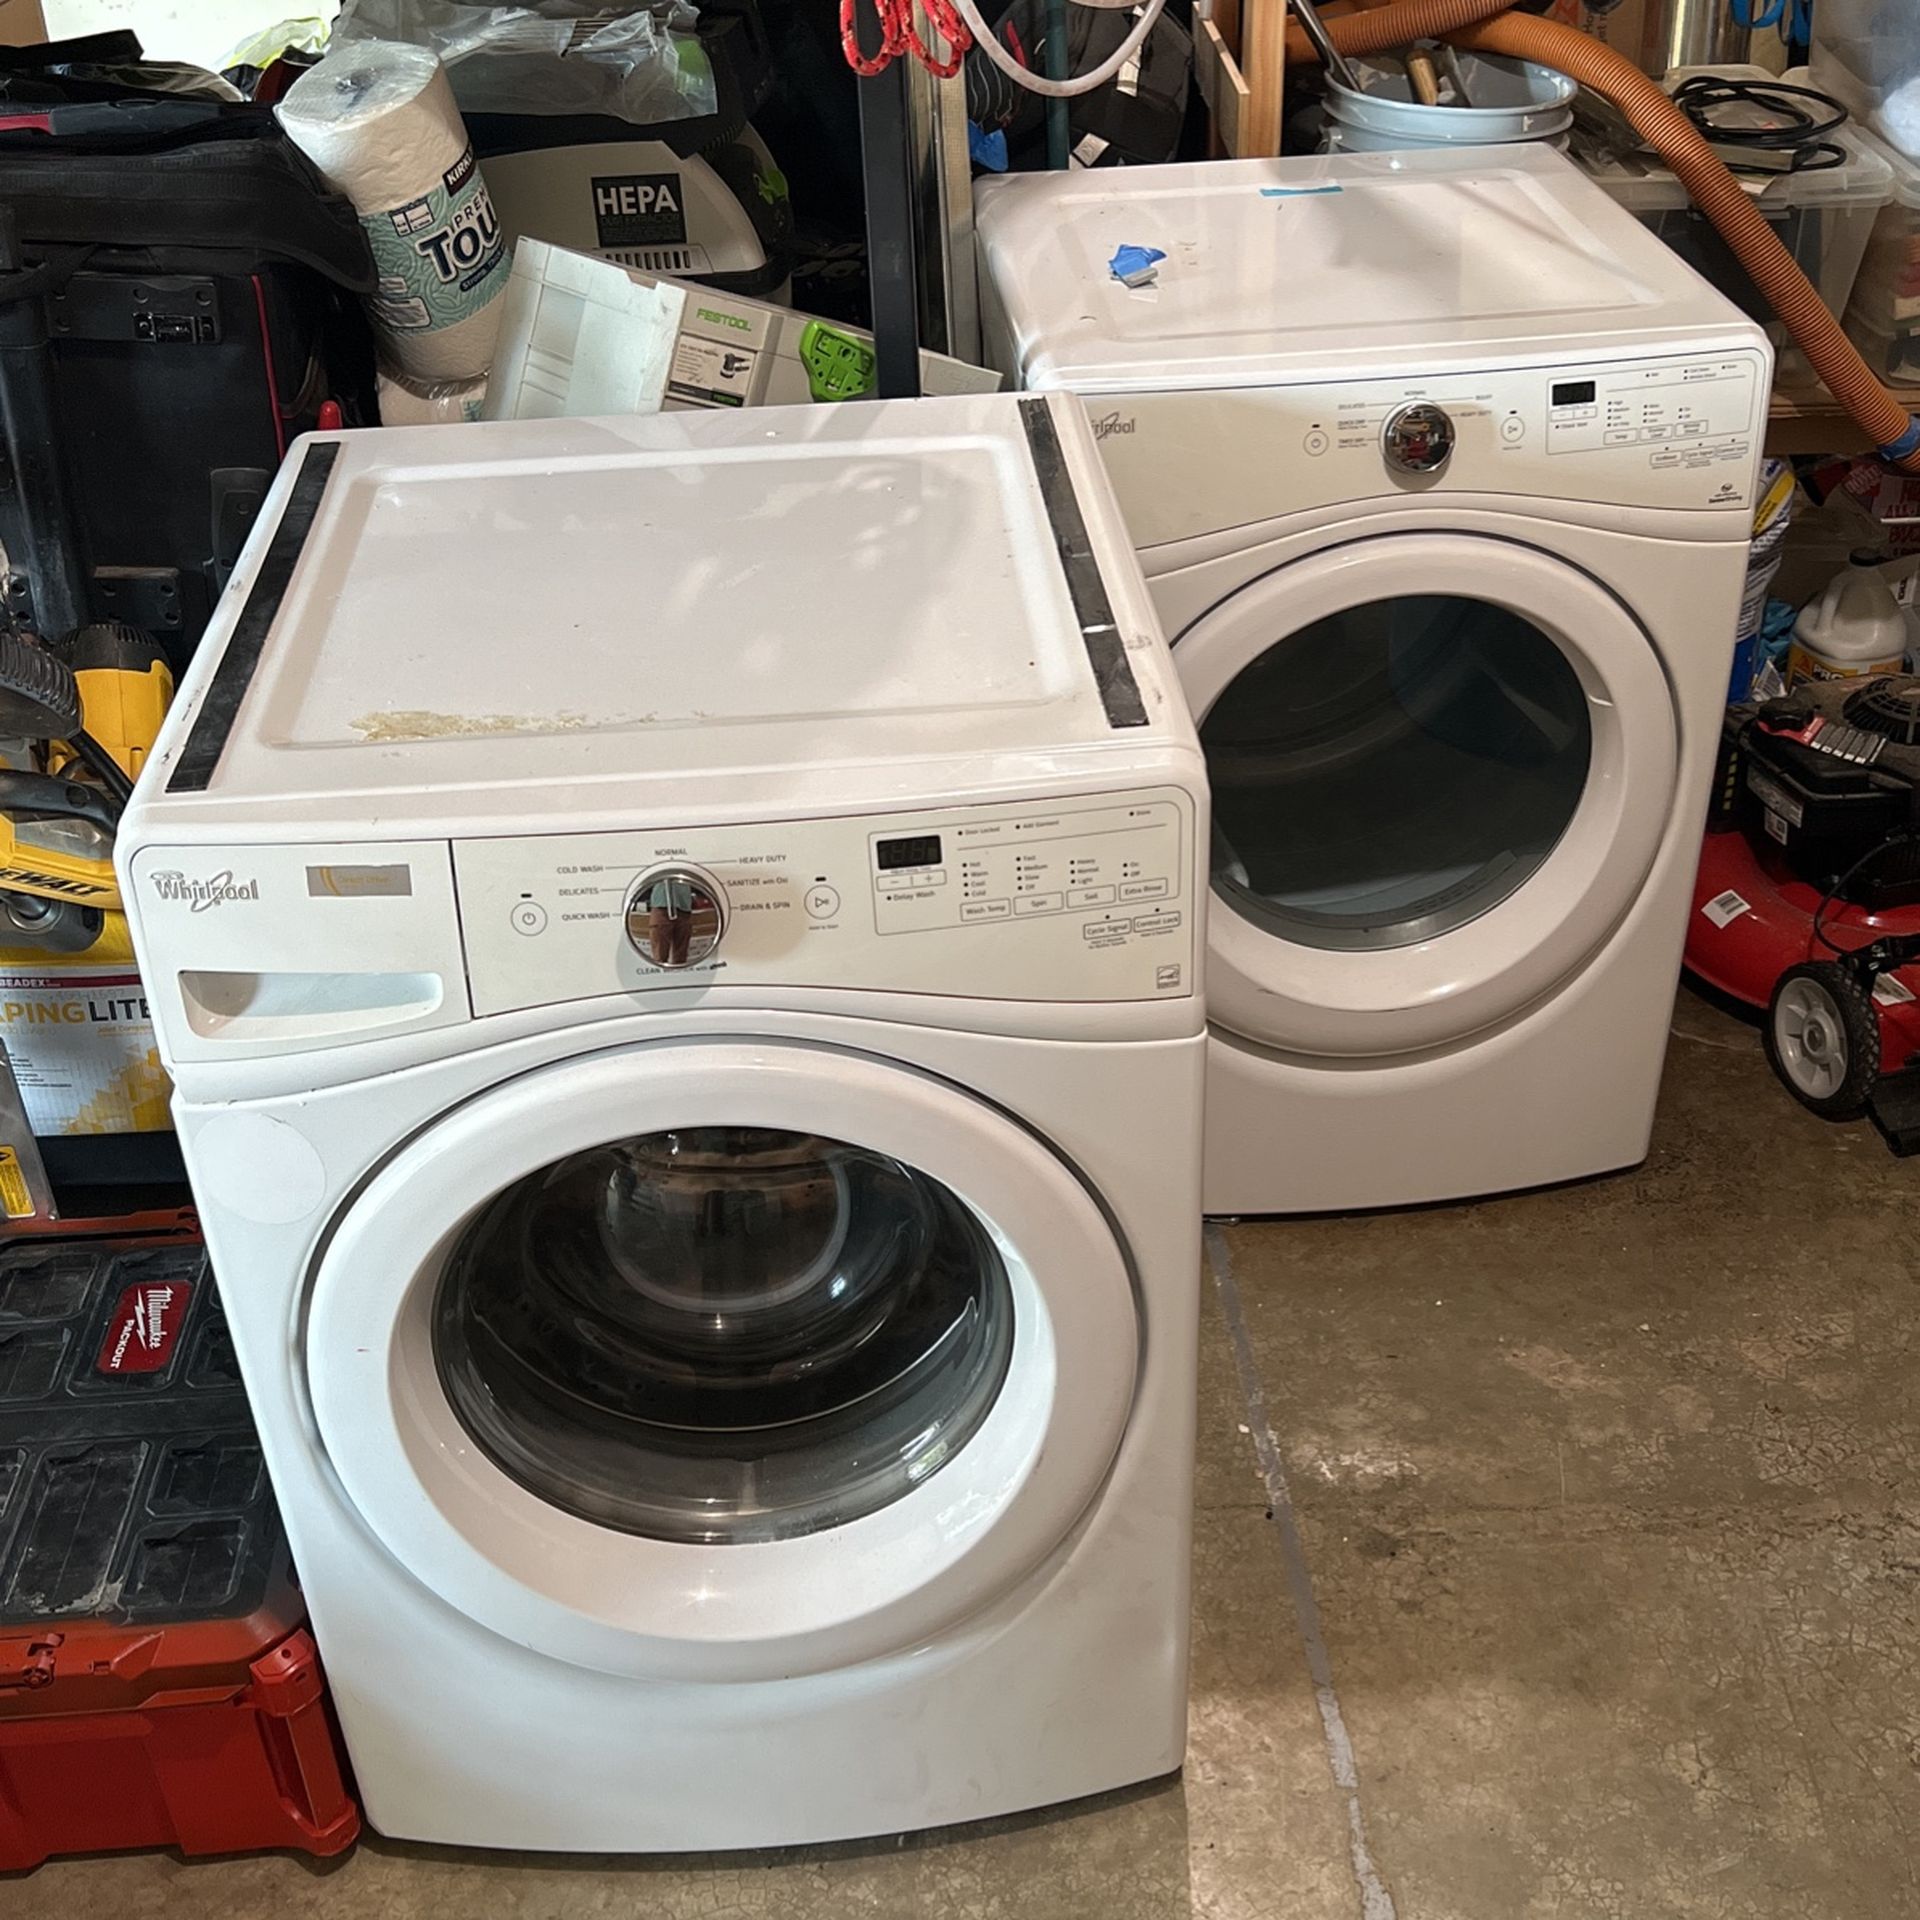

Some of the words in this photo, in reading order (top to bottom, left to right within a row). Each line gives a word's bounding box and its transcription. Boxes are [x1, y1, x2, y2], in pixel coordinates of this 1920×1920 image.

[597, 184, 679, 215] HEPA
[696, 308, 753, 332] FESTOOL
[654, 848, 688, 856] NORMAL
[739, 857, 764, 865] HEAVY
[766, 855, 787, 863] DUTY
[557, 866, 578, 874] COLD
[580, 865, 604, 873] WASH
[727, 879, 760, 887] SANITIZE
[150, 870, 259, 912] Whirlpool
[559, 887, 599, 896] DELICATES
[740, 903, 763, 911] DRAIN
[562, 913, 586, 921] QUICK
[587, 912, 610, 920] WASH
[636, 966, 661, 975] CLEAN
[146, 1286, 174, 1349] Milwaukee
[110, 1319, 135, 1369] PACKOUT
